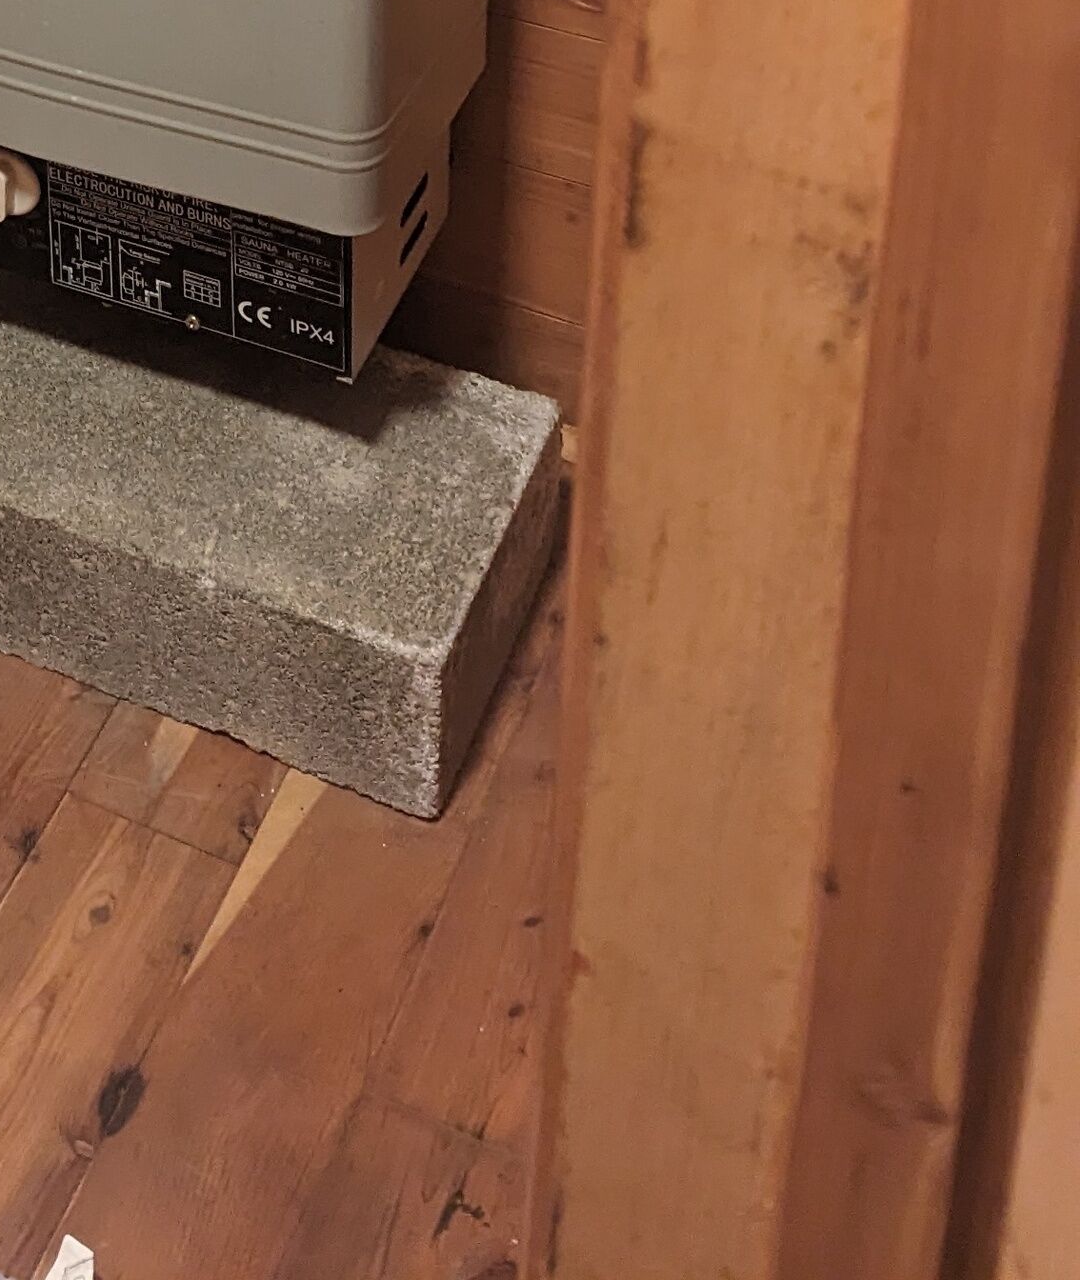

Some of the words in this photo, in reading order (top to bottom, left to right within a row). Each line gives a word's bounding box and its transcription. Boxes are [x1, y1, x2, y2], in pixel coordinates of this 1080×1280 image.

[48, 166, 154, 208] ELECTROCUTION
[158, 199, 184, 216] AND
[187, 206, 231, 230] BURNS
[240, 235, 278, 253] SAUNA
[286, 249, 331, 268] HEATER
[238, 267, 264, 281] POWER
[290, 318, 335, 345] IPX4
